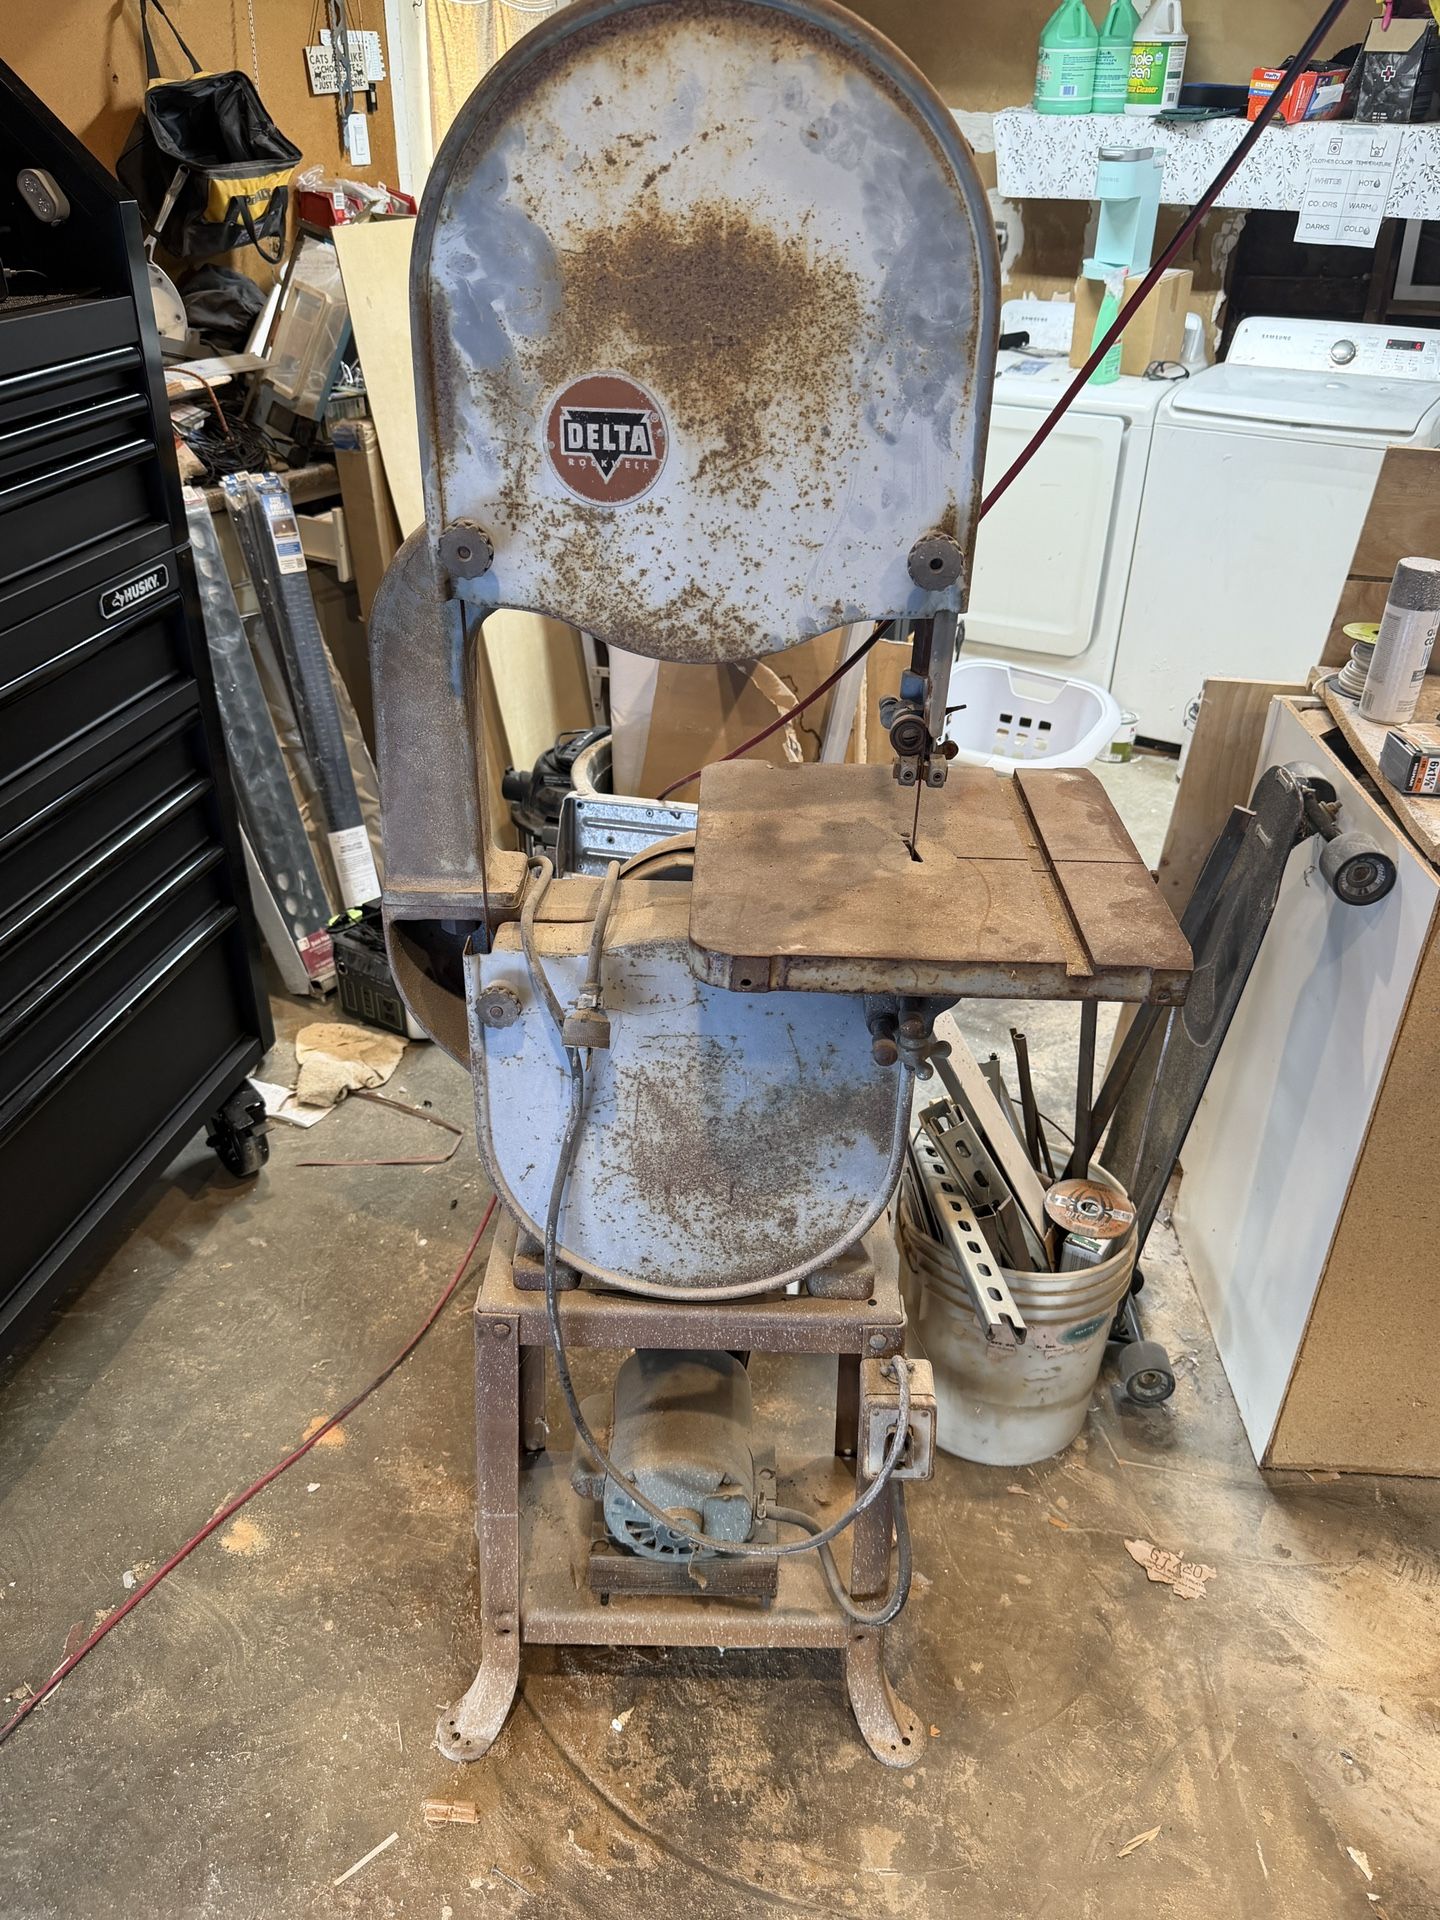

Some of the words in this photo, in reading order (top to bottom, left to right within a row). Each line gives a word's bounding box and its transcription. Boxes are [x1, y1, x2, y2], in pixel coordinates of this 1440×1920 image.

[309, 54, 329, 65] CATS
[350, 52, 363, 63] IKE
[1130, 50, 1154, 66] mple
[1129, 66, 1151, 79] een
[319, 81, 333, 90] JUST
[1136, 86, 1158, 94] Cleaner
[1358, 179, 1374, 187] HOT
[1308, 200, 1338, 209] COORS
[1305, 223, 1330, 231] DARKS
[1344, 225, 1364, 233] COLD
[1262, 334, 1292, 342] SAMSUNG
[567, 422, 648, 452] DELTA
[568, 458, 649, 470] ROCKWELL
